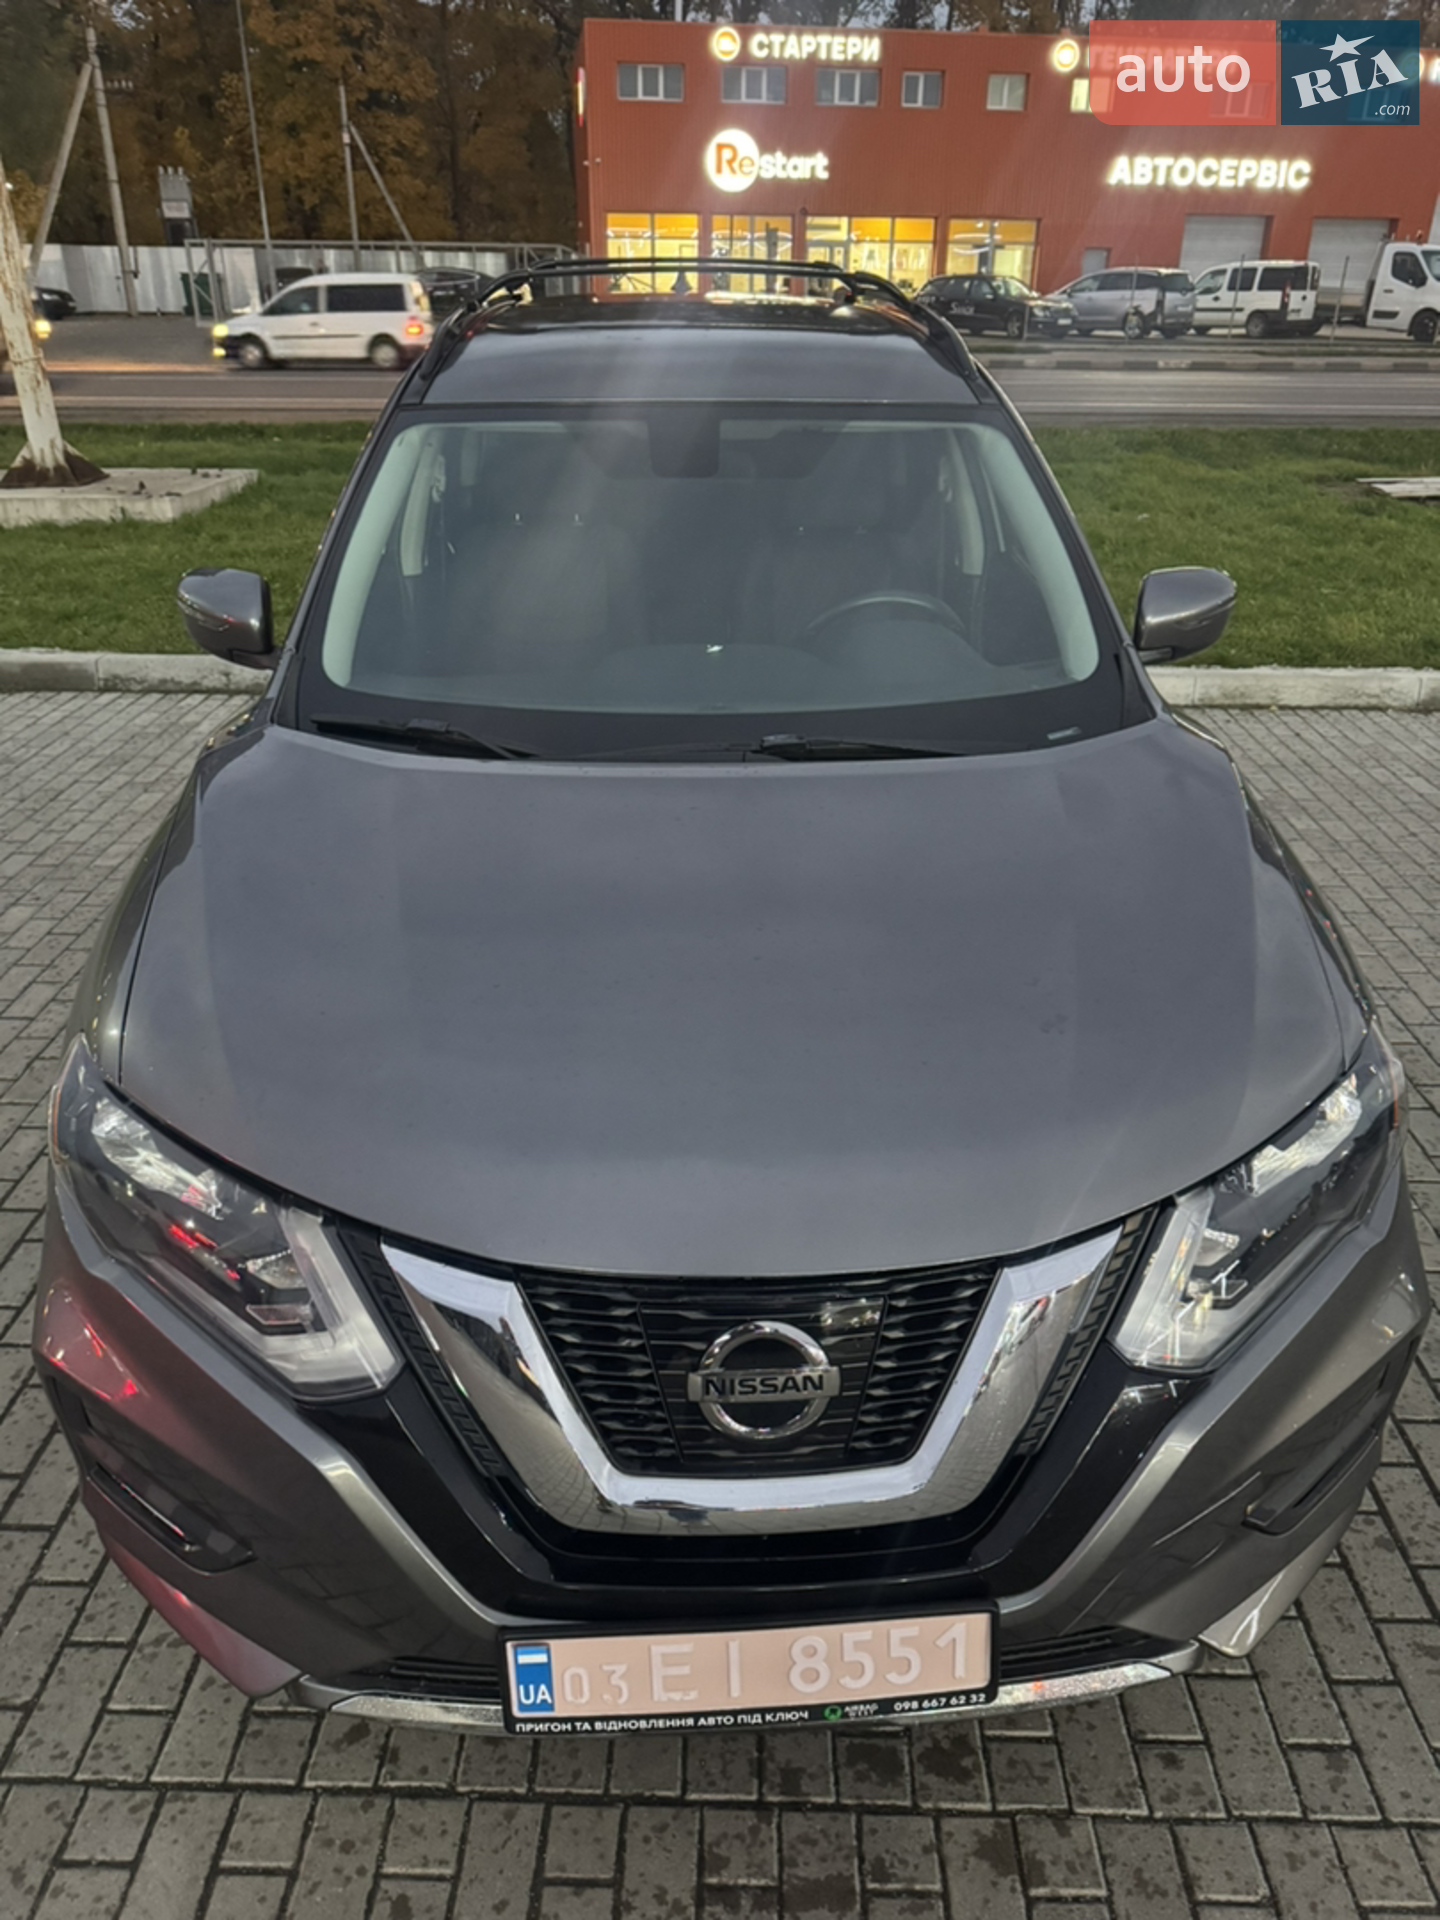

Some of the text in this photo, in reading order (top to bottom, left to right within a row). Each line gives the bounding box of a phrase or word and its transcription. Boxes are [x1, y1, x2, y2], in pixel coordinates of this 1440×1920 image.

[750, 32, 881, 62] СТАРТЕРИ
[715, 141, 829, 179] Restart
[1107, 154, 1312, 190] АВТОСЕРВІС
[704, 1374, 824, 1396] NISSAN
[563, 1662, 630, 1705] 03
[788, 1621, 967, 1694] 8551
[518, 1683, 552, 1705] UA
[893, 1693, 987, 1712] 098 667 62 32
[515, 1710, 809, 1733] ПРИГОН ТА ВІДНОВЛЕННЯ АВТО ПІД КЛЮЧ
